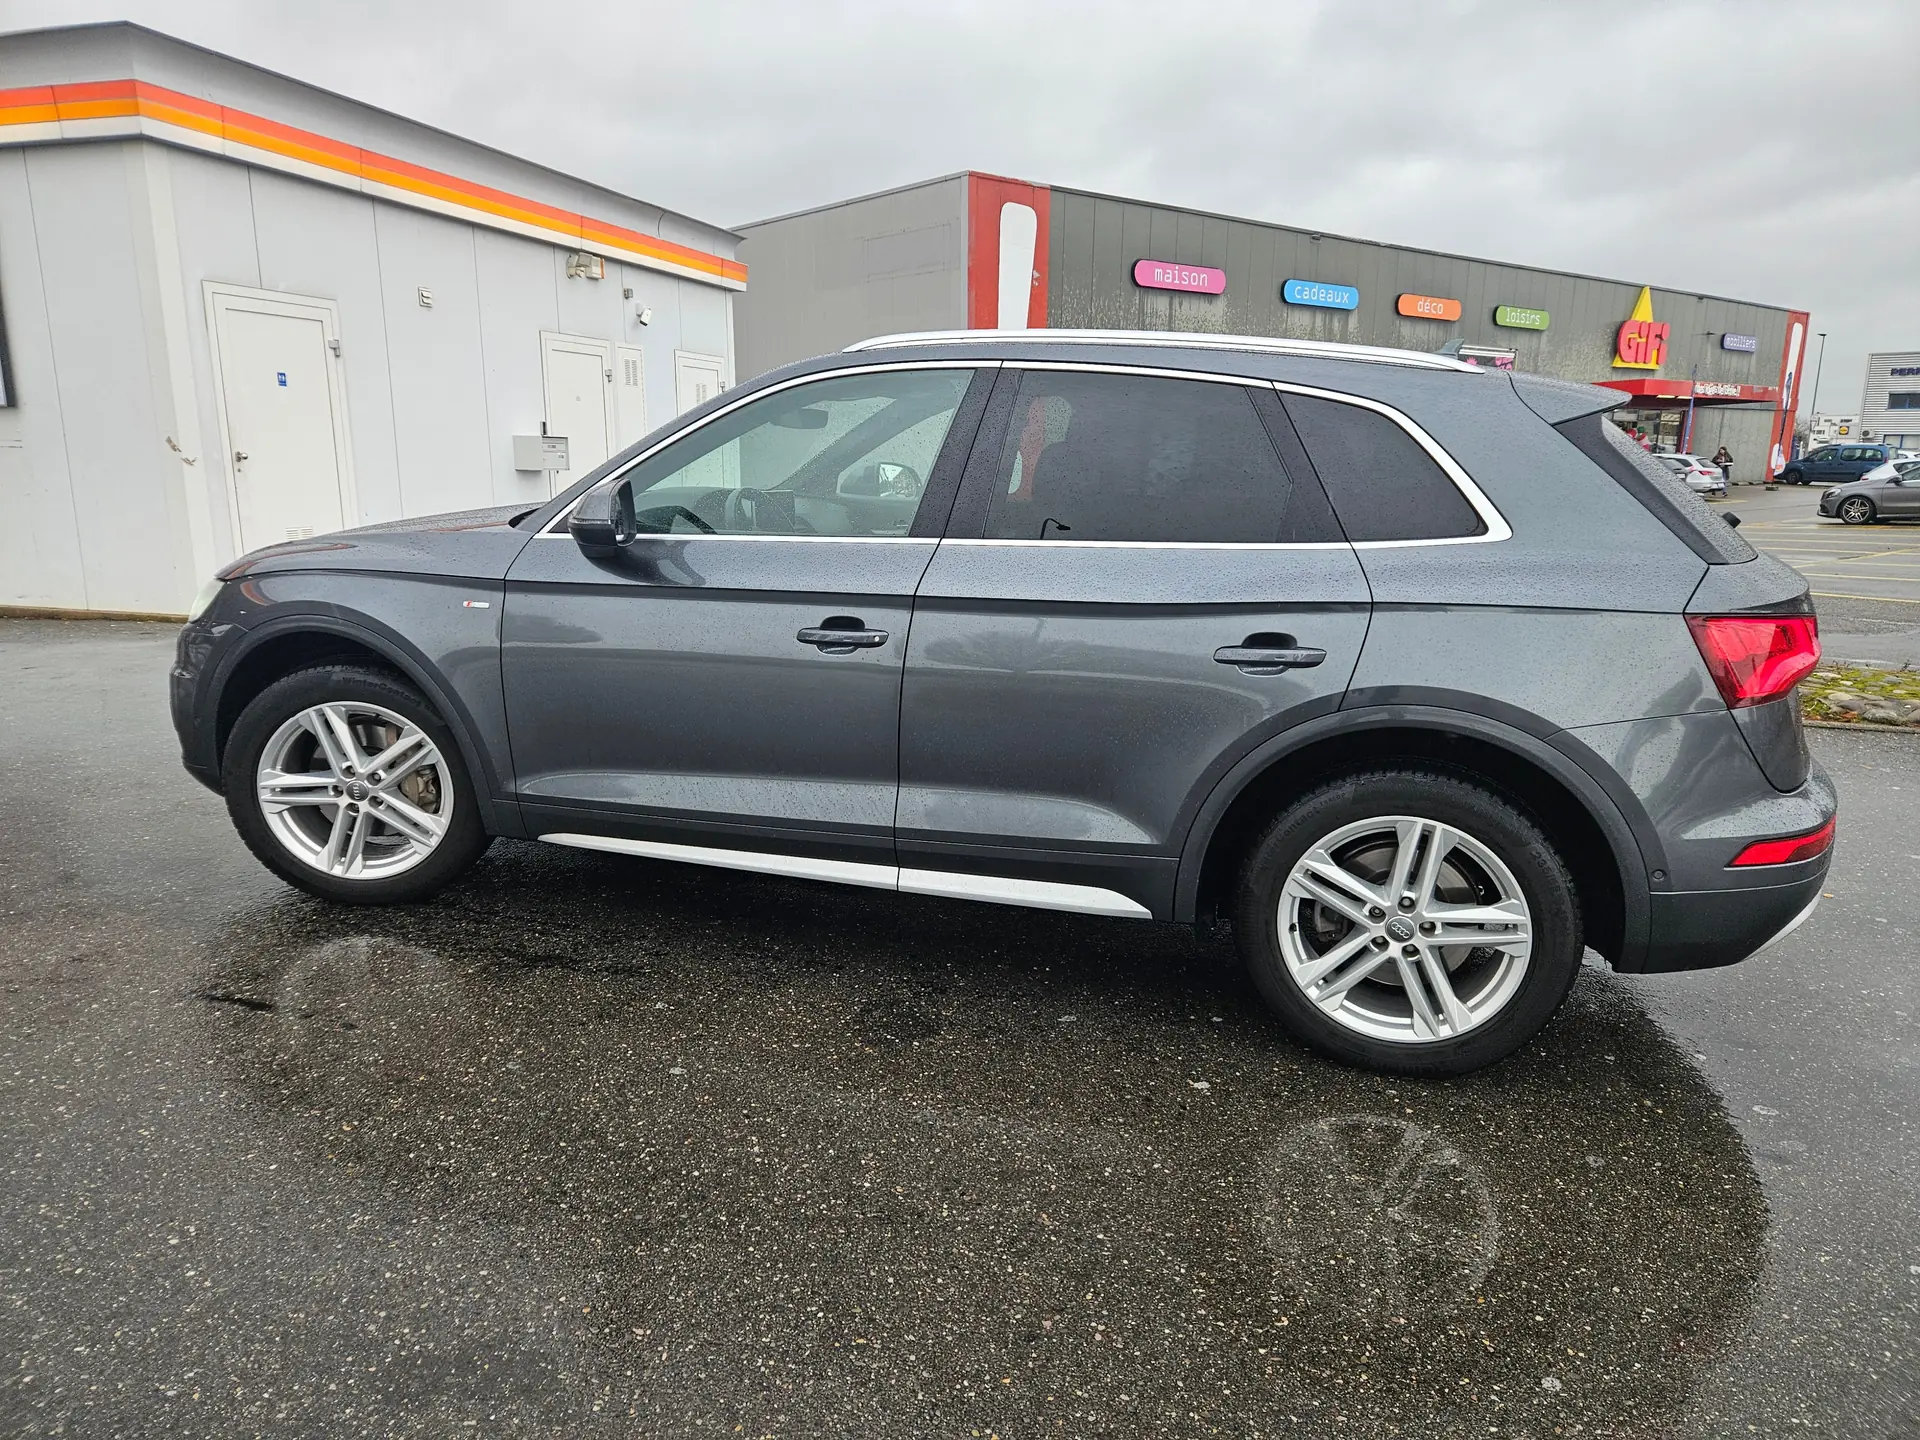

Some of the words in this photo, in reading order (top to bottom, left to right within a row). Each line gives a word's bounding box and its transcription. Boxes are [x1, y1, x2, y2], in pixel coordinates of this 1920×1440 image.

[1154, 265, 1208, 287] maison
[1294, 284, 1349, 304] cadeaux
[1417, 297, 1444, 315] déco
[1505, 307, 1541, 325] loisirs
